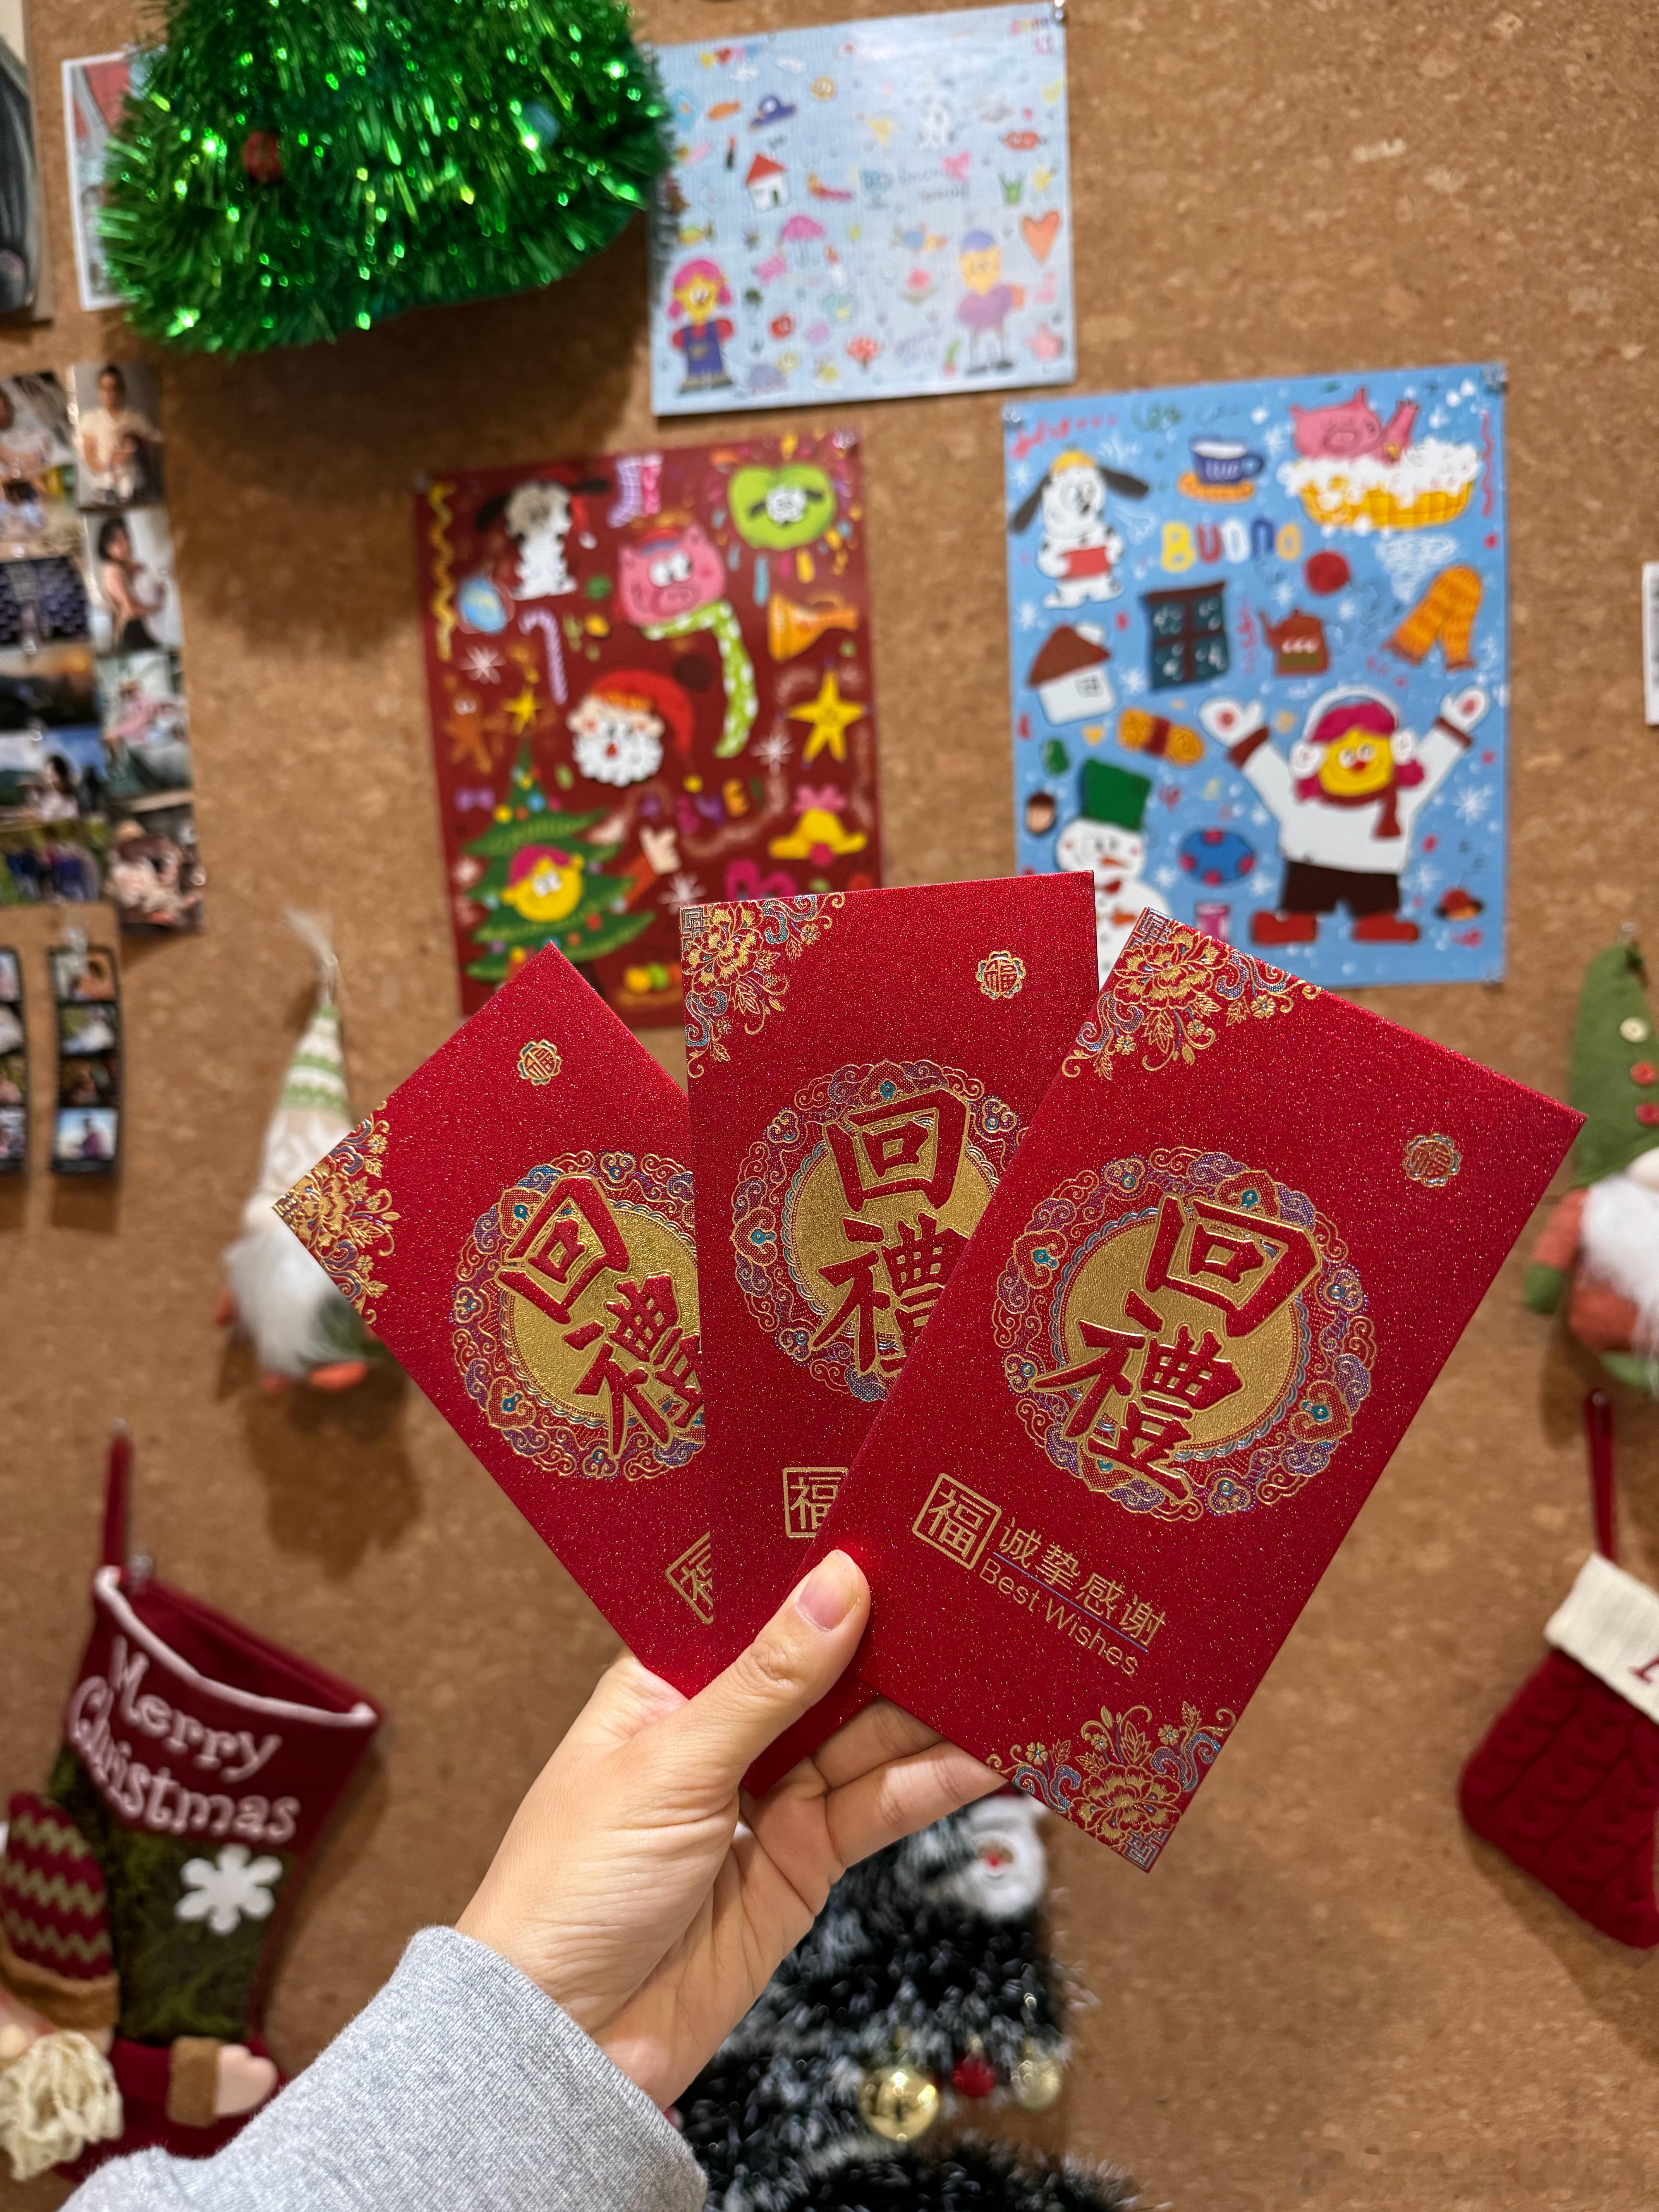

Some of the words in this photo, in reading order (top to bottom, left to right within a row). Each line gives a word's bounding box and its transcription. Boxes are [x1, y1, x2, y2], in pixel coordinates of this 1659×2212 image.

[1030, 1194, 1321, 1504] 回禮
[926, 1486, 993, 1559] 福
[998, 1517, 1166, 1646] 诚挚感谢
[979, 1558, 1040, 1612] Best
[1045, 1598, 1139, 1676] Wishes
[66, 1675, 301, 1844] Christmas
[108, 1634, 283, 1782] Merry
